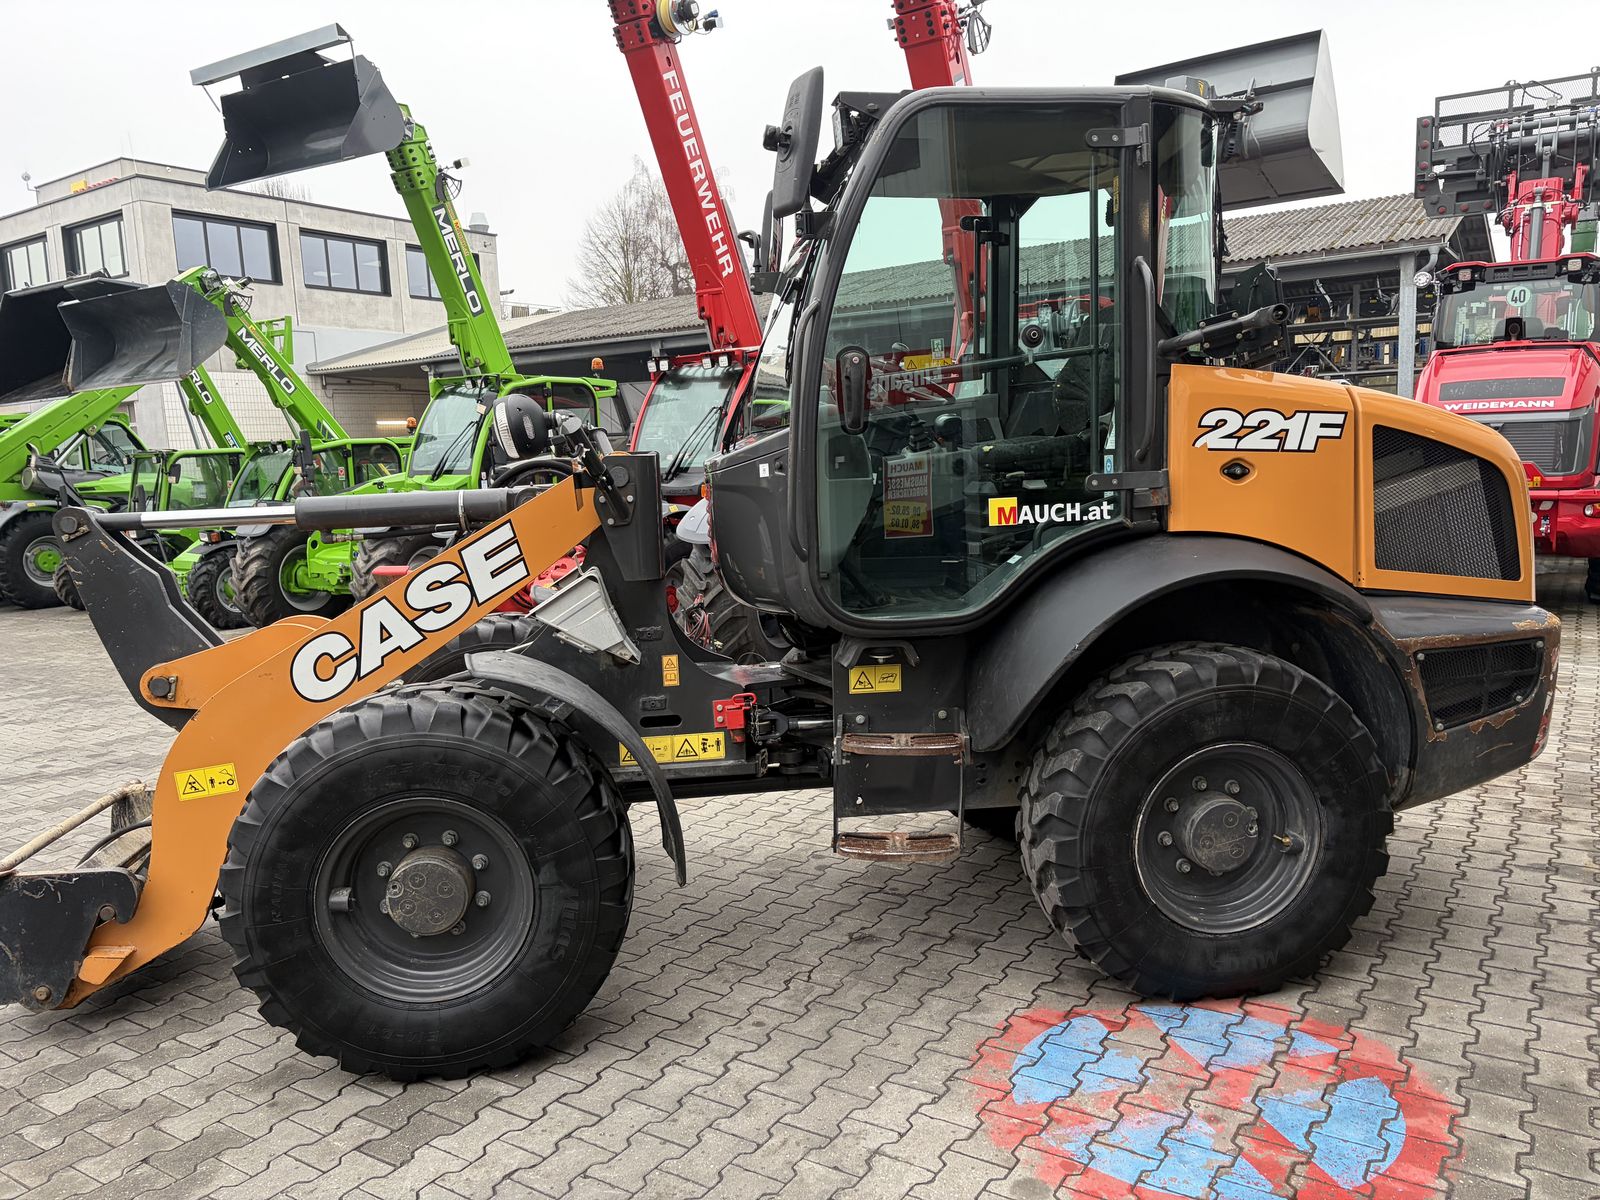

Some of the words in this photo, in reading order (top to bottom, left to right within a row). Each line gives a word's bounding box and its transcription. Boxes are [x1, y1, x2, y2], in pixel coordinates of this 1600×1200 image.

[662, 69, 735, 279] FEUERWEHR
[434, 207, 481, 313] MERLO
[1511, 289, 1526, 303] 40
[236, 327, 295, 394] MERLO
[190, 369, 213, 405] RLO
[1444, 400, 1555, 411] WEIDEMANN
[1192, 407, 1348, 453] 221F
[996, 501, 1112, 525] MAUCH.at
[290, 518, 531, 703] CASE
